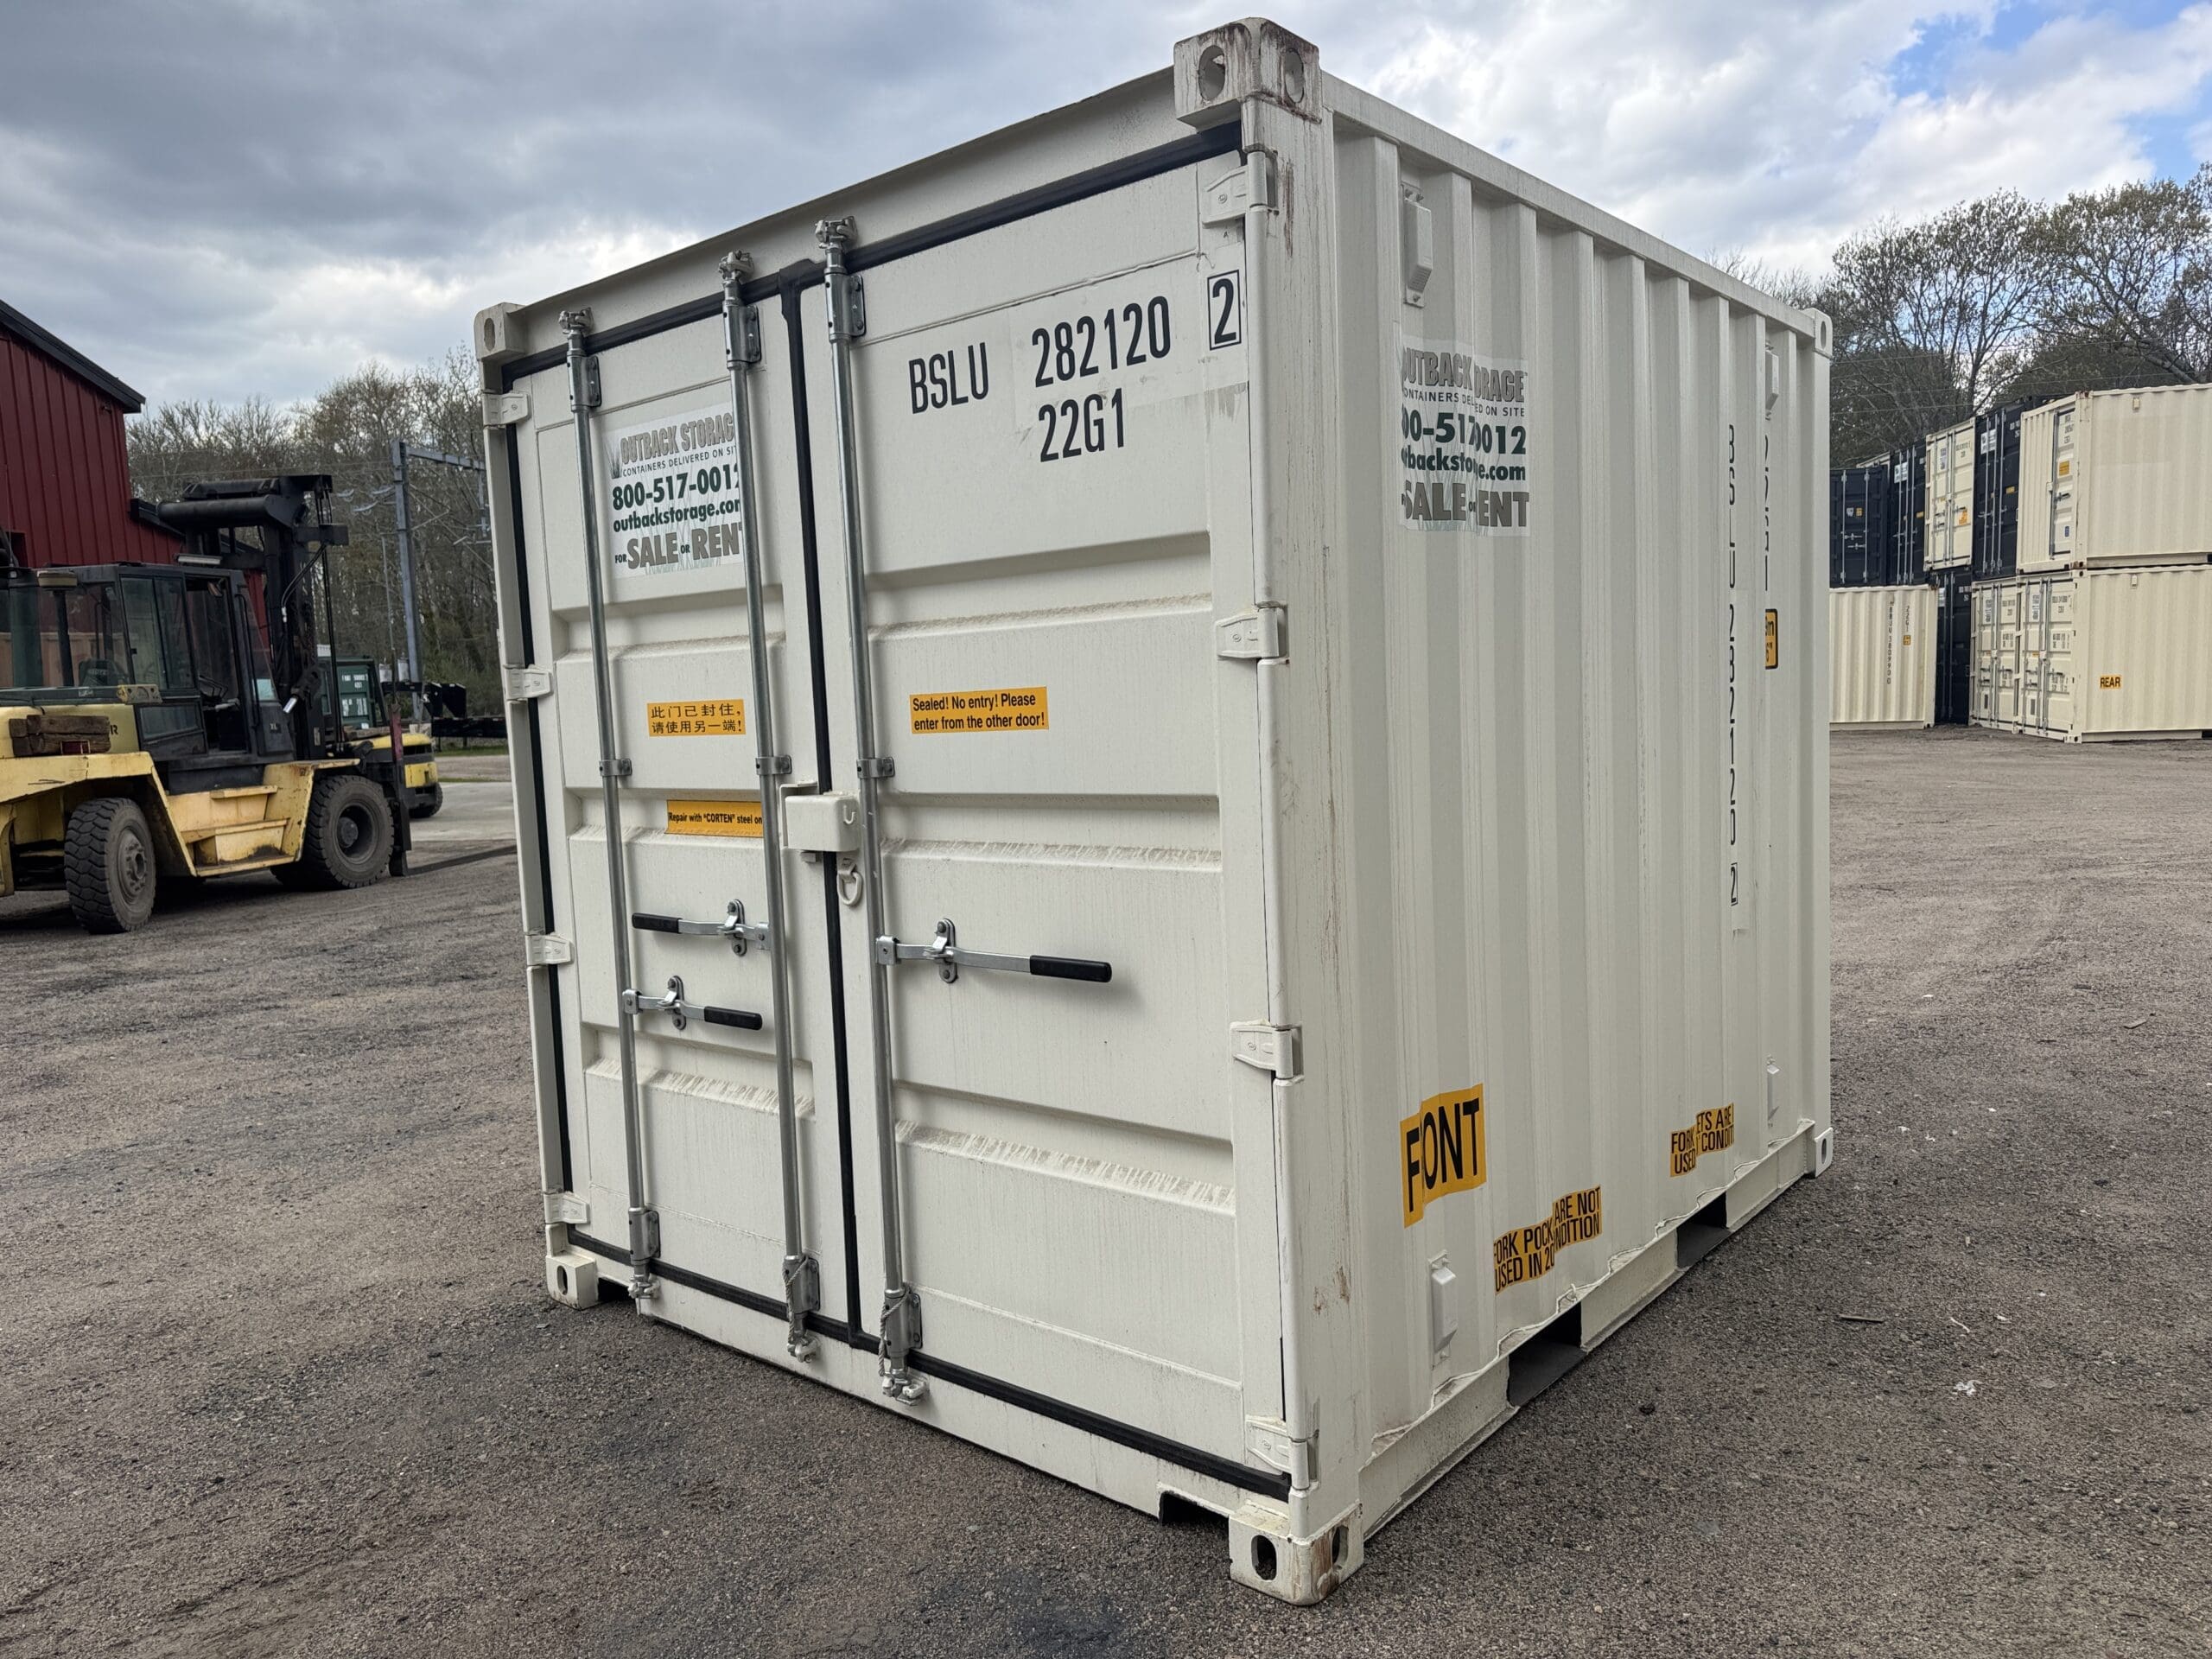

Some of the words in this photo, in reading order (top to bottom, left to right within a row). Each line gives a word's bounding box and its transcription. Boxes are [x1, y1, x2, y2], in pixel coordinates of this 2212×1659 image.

[908, 342, 989, 414] BSLU
[1032, 296, 1171, 388] 282120
[1211, 277, 1237, 345] 2
[1403, 387, 1459, 403] ONTAINERS
[1485, 405, 1497, 416] ON
[1503, 407, 1525, 417] SITE
[1473, 363, 1524, 403] ORAGE
[620, 425, 679, 465] OUTBACK
[680, 412, 734, 452] STORAG
[1038, 388, 1124, 462] 22G1
[622, 461, 666, 477] CONTAINERS
[668, 451, 709, 468] DELIVERED
[712, 448, 724, 459] ON
[726, 445, 737, 456] SI
[1405, 480, 1466, 521] SALE
[1478, 490, 1529, 527] ENT
[614, 554, 627, 563] FOR
[626, 531, 679, 569] SALE
[680, 543, 690, 554] OR
[691, 522, 742, 561] REN
[912, 696, 949, 711] Sealed!
[951, 696, 966, 709] No
[968, 694, 999, 711] entry!
[1001, 693, 1036, 707] Please
[2100, 677, 2121, 688] REAR
[914, 718, 939, 730] enter
[941, 716, 964, 729] from
[967, 715, 983, 728] the
[986, 714, 1013, 728] other
[1015, 712, 1045, 727] door!
[668, 812, 688, 823] Repair
[689, 812, 702, 822] with
[736, 814, 753, 824] steel
[1671, 1127, 1695, 1154] FORK
[1715, 1105, 1732, 1129] ARE
[1675, 1148, 1696, 1174] USED
[1701, 1124, 1734, 1152] CONDIT
[1406, 1097, 1479, 1212] FONT
[1523, 1217, 1554, 1254] POCK
[1554, 1196, 1573, 1227] ARE
[1577, 1186, 1600, 1216] NOT
[1495, 1256, 1523, 1293] USED
[1528, 1250, 1542, 1278] IN
[1554, 1211, 1599, 1252] NDITION
